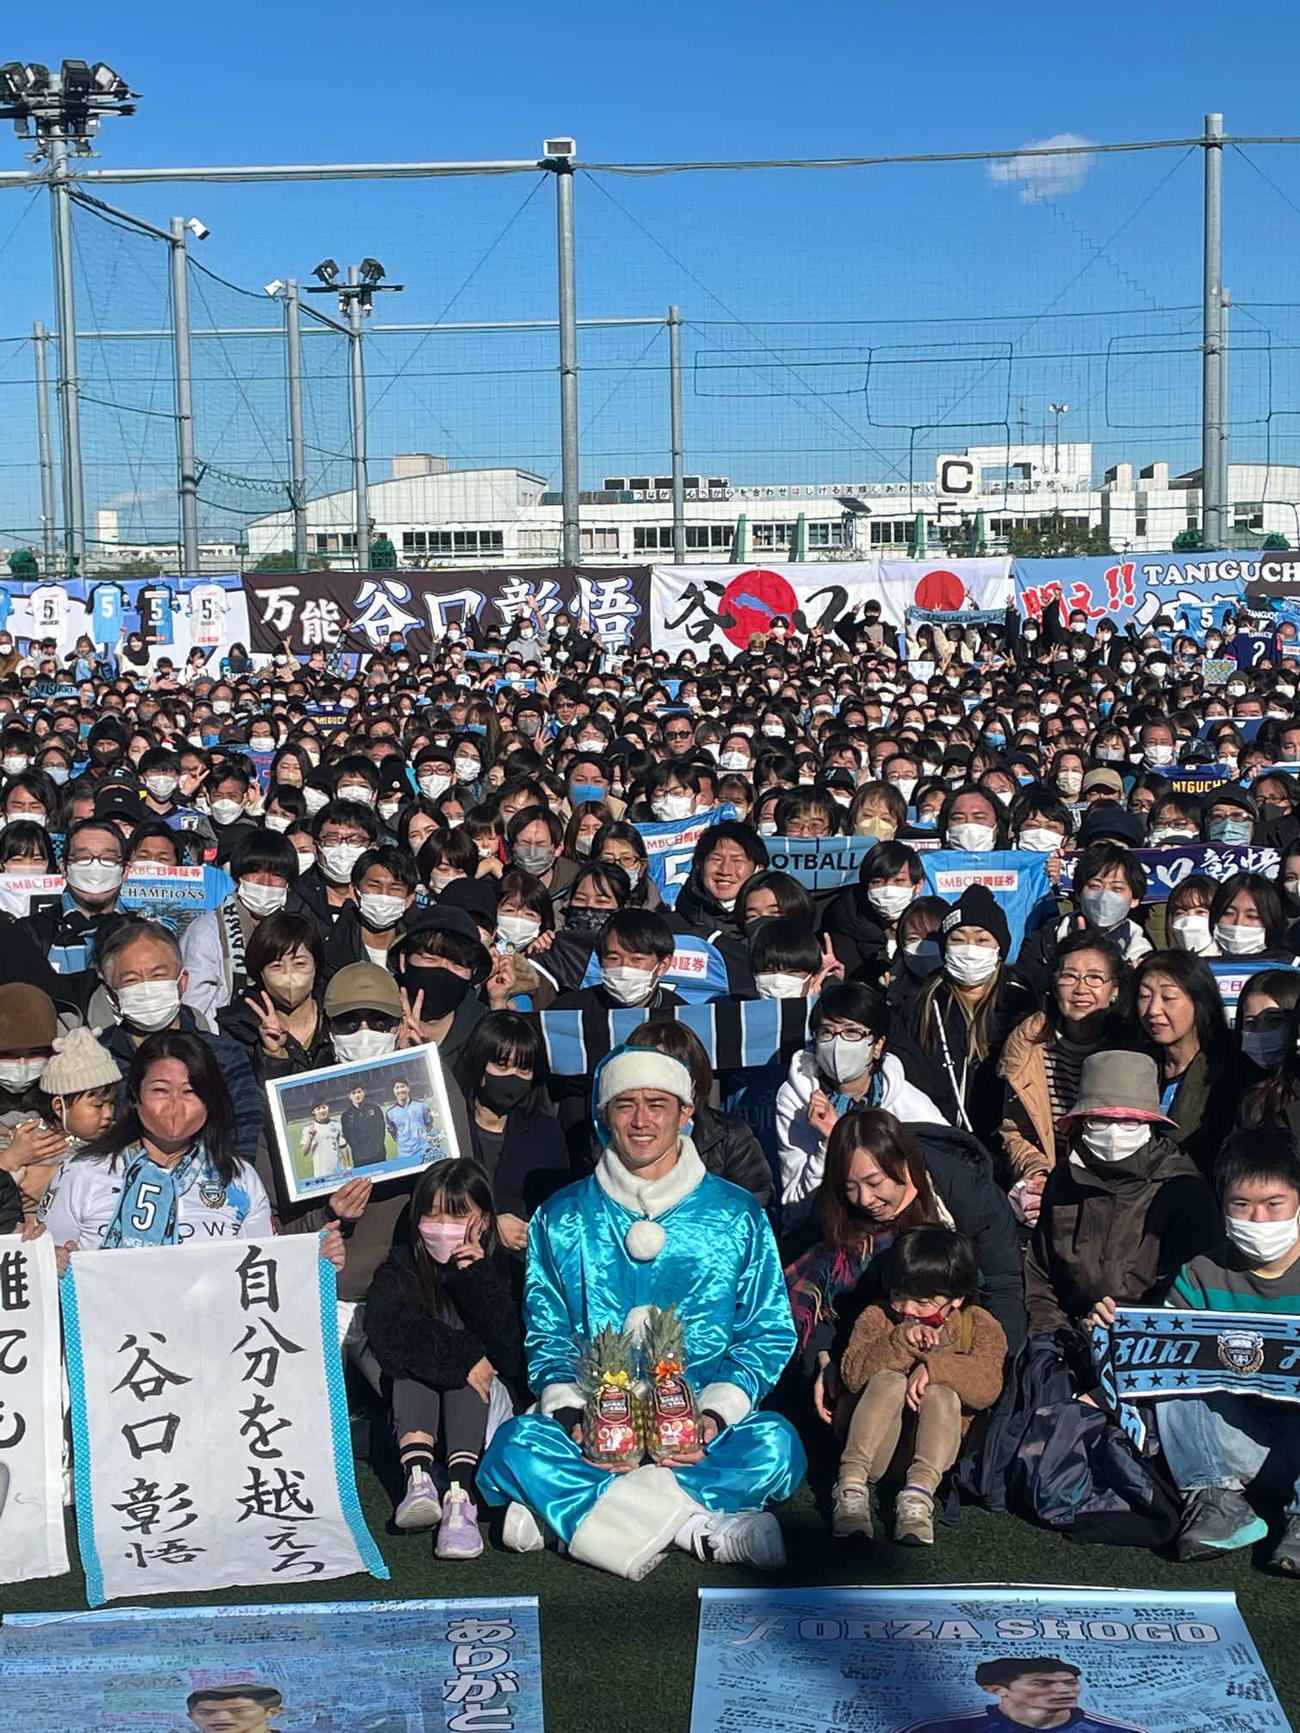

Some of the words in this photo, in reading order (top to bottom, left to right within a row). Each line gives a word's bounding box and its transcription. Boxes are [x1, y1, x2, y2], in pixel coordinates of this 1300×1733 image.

[942, 460, 973, 493] C
[1143, 561, 1300, 586] TANIGUCH
[43, 600, 55, 619] 5
[102, 596, 114, 617] 5
[151, 598, 163, 620] 5
[202, 598, 212, 619] 5
[1200, 607, 1214, 628] 5
[771, 851, 860, 870] OTBALL
[131, 1181, 162, 1232] 5
[111, 1331, 206, 1568] 谷口彰悟
[995, 1617, 1220, 1644] SHOGO
[442, 1618, 519, 1733] ありがと
